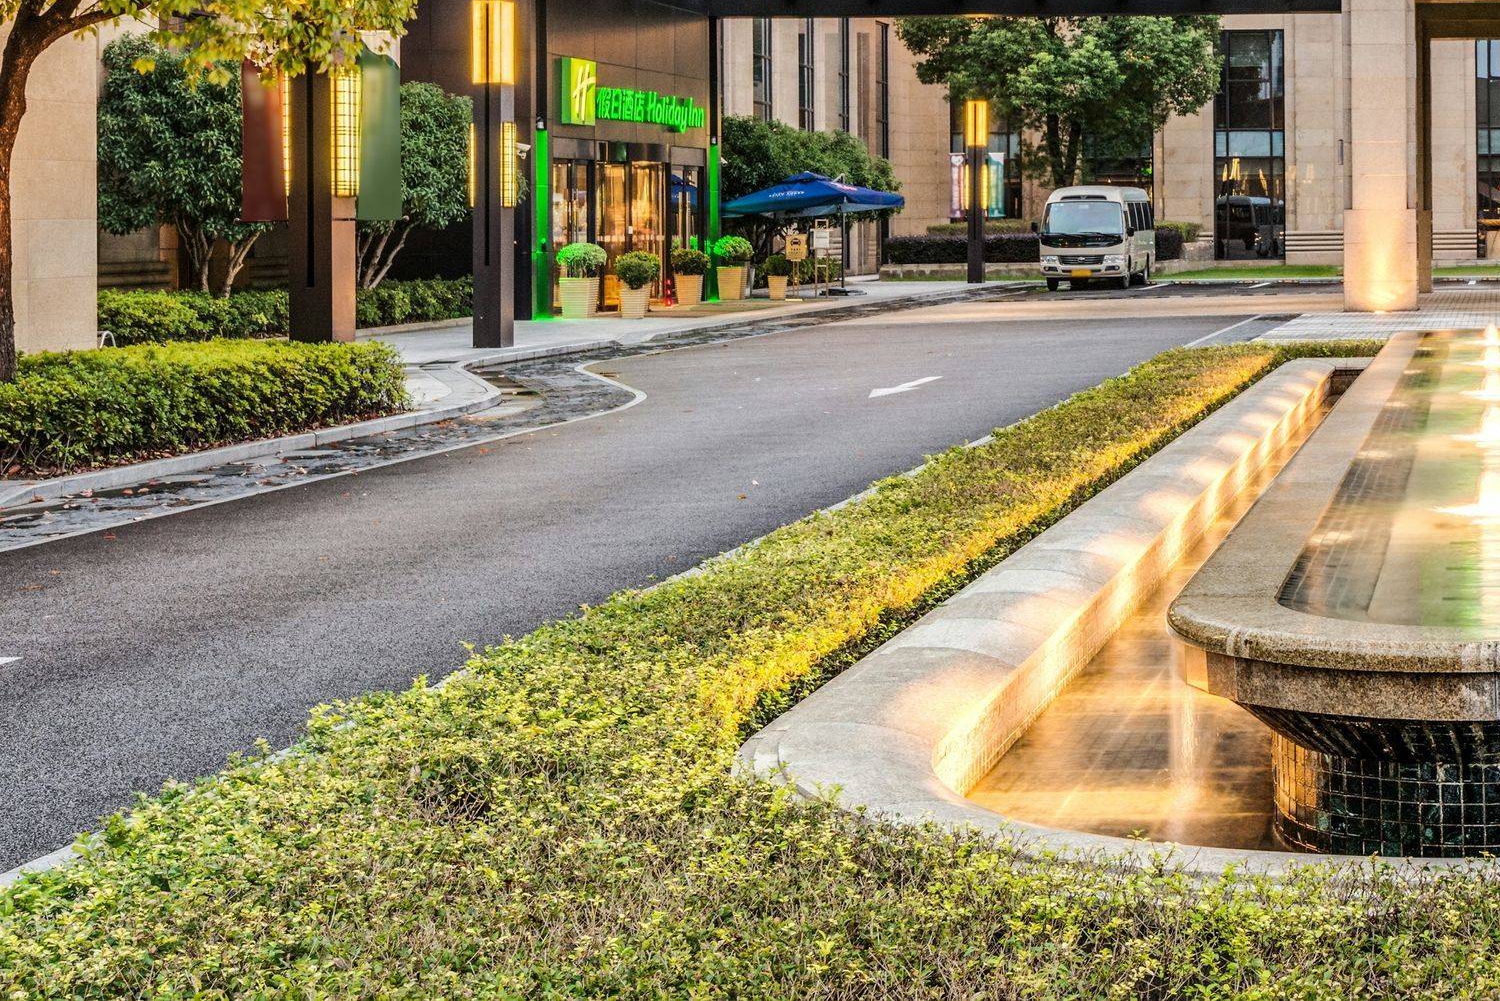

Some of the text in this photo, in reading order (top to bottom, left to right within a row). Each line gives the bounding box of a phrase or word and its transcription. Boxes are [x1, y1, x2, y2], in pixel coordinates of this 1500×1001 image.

[597, 87, 645, 122] 假日酒店
[647, 91, 704, 133] Holiday Inn
